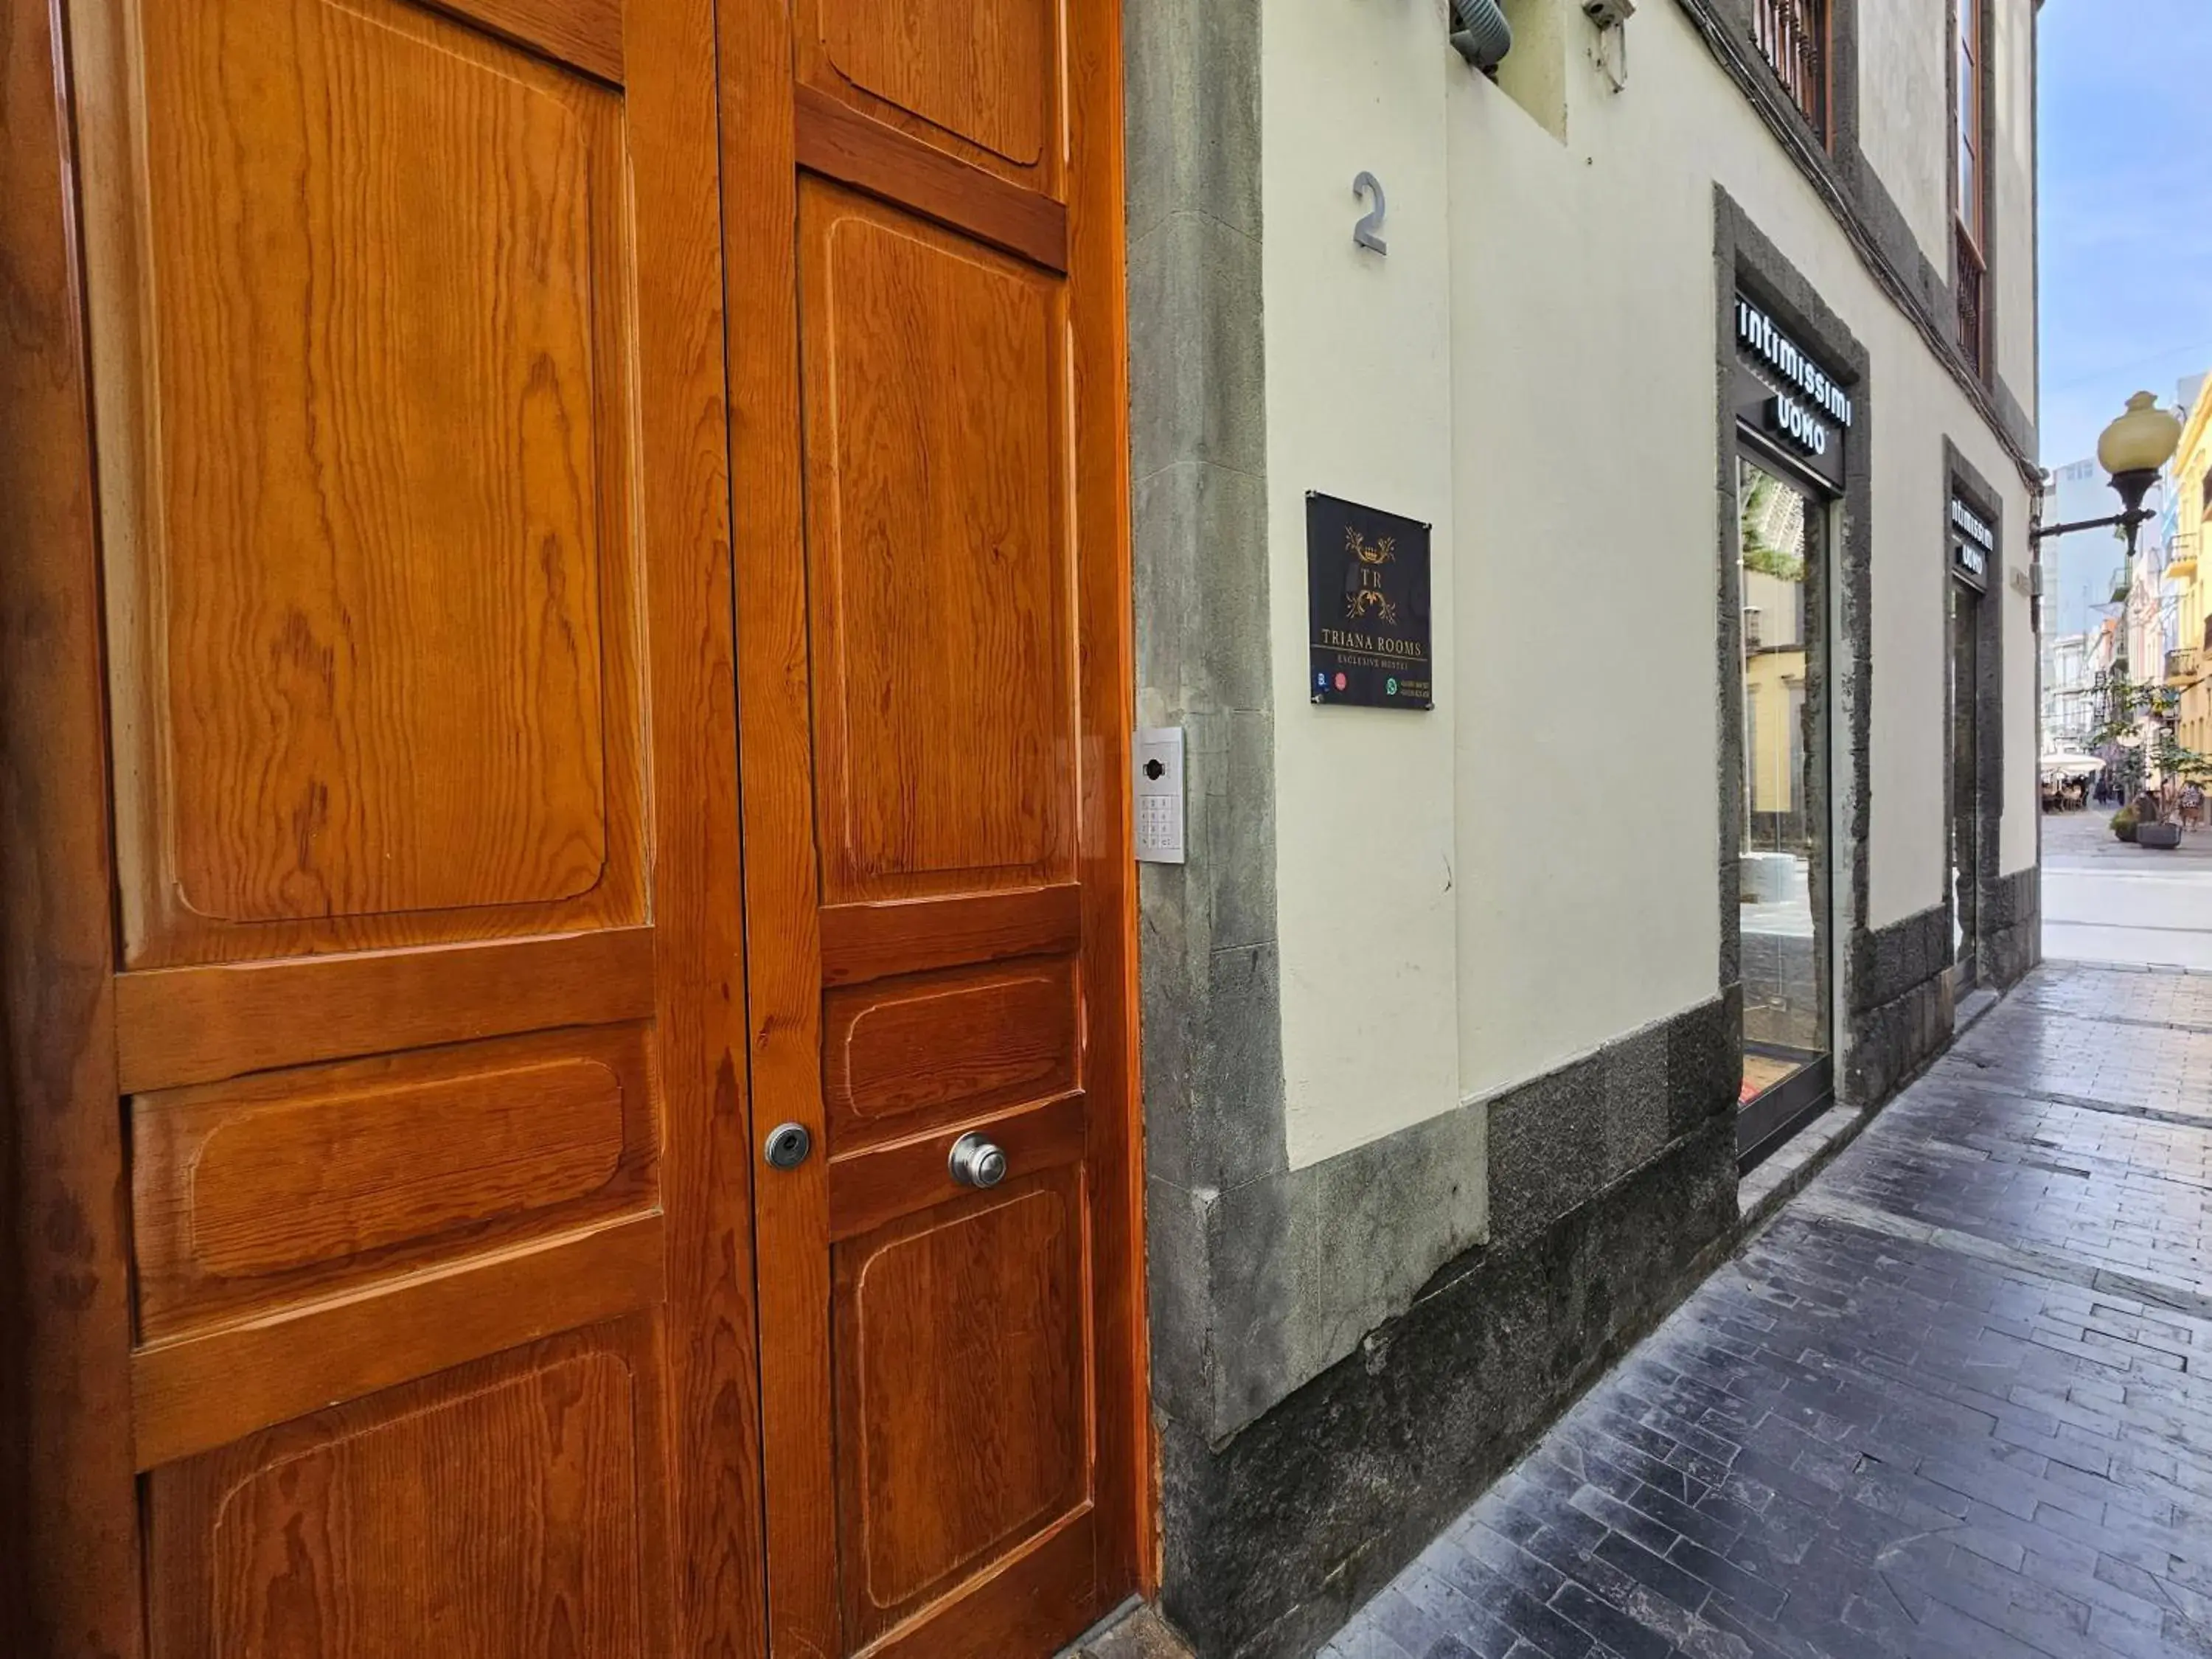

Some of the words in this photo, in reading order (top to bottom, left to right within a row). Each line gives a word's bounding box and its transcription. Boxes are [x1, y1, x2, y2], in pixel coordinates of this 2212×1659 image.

[1352, 170, 1387, 256] 2
[1740, 302, 1851, 428] intimissimi
[1778, 392, 1825, 454] UOMO
[1952, 500, 1993, 552] ntimissimi
[1322, 628, 1372, 650] TRIANA
[1377, 636, 1422, 655] ROOMS
